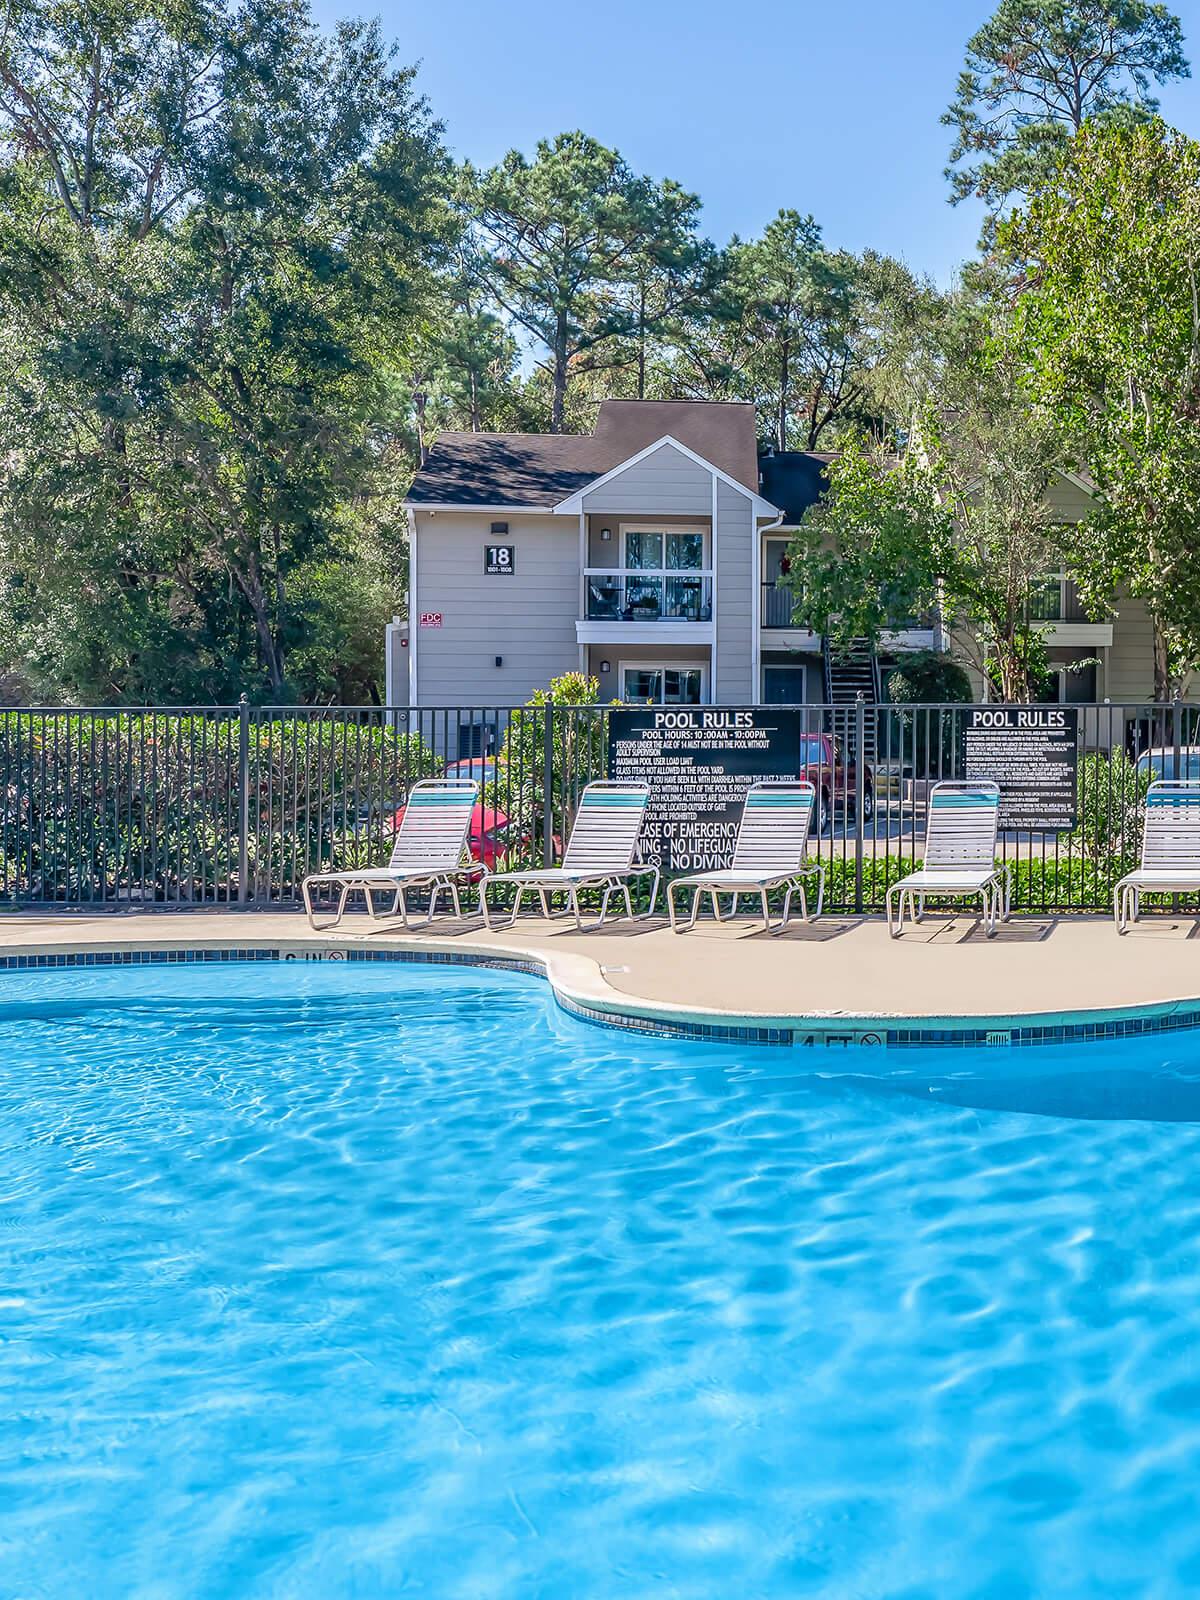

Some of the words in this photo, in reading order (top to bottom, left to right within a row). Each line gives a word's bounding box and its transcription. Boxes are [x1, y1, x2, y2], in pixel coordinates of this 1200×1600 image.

[489, 548, 510, 564] 18
[421, 613, 441, 622] FDC
[655, 712, 699, 728] POOL
[703, 712, 754, 728] RULES
[973, 711, 1013, 727] POOL
[1018, 711, 1065, 727] RULES
[642, 731, 663, 739] POOL
[664, 731, 693, 739] HOURS:
[735, 731, 767, 739] 10:00PM
[664, 823, 678, 837] OF
[680, 823, 739, 837] EMERGENCY
[670, 839, 686, 853] NO
[670, 855, 690, 869] NO
